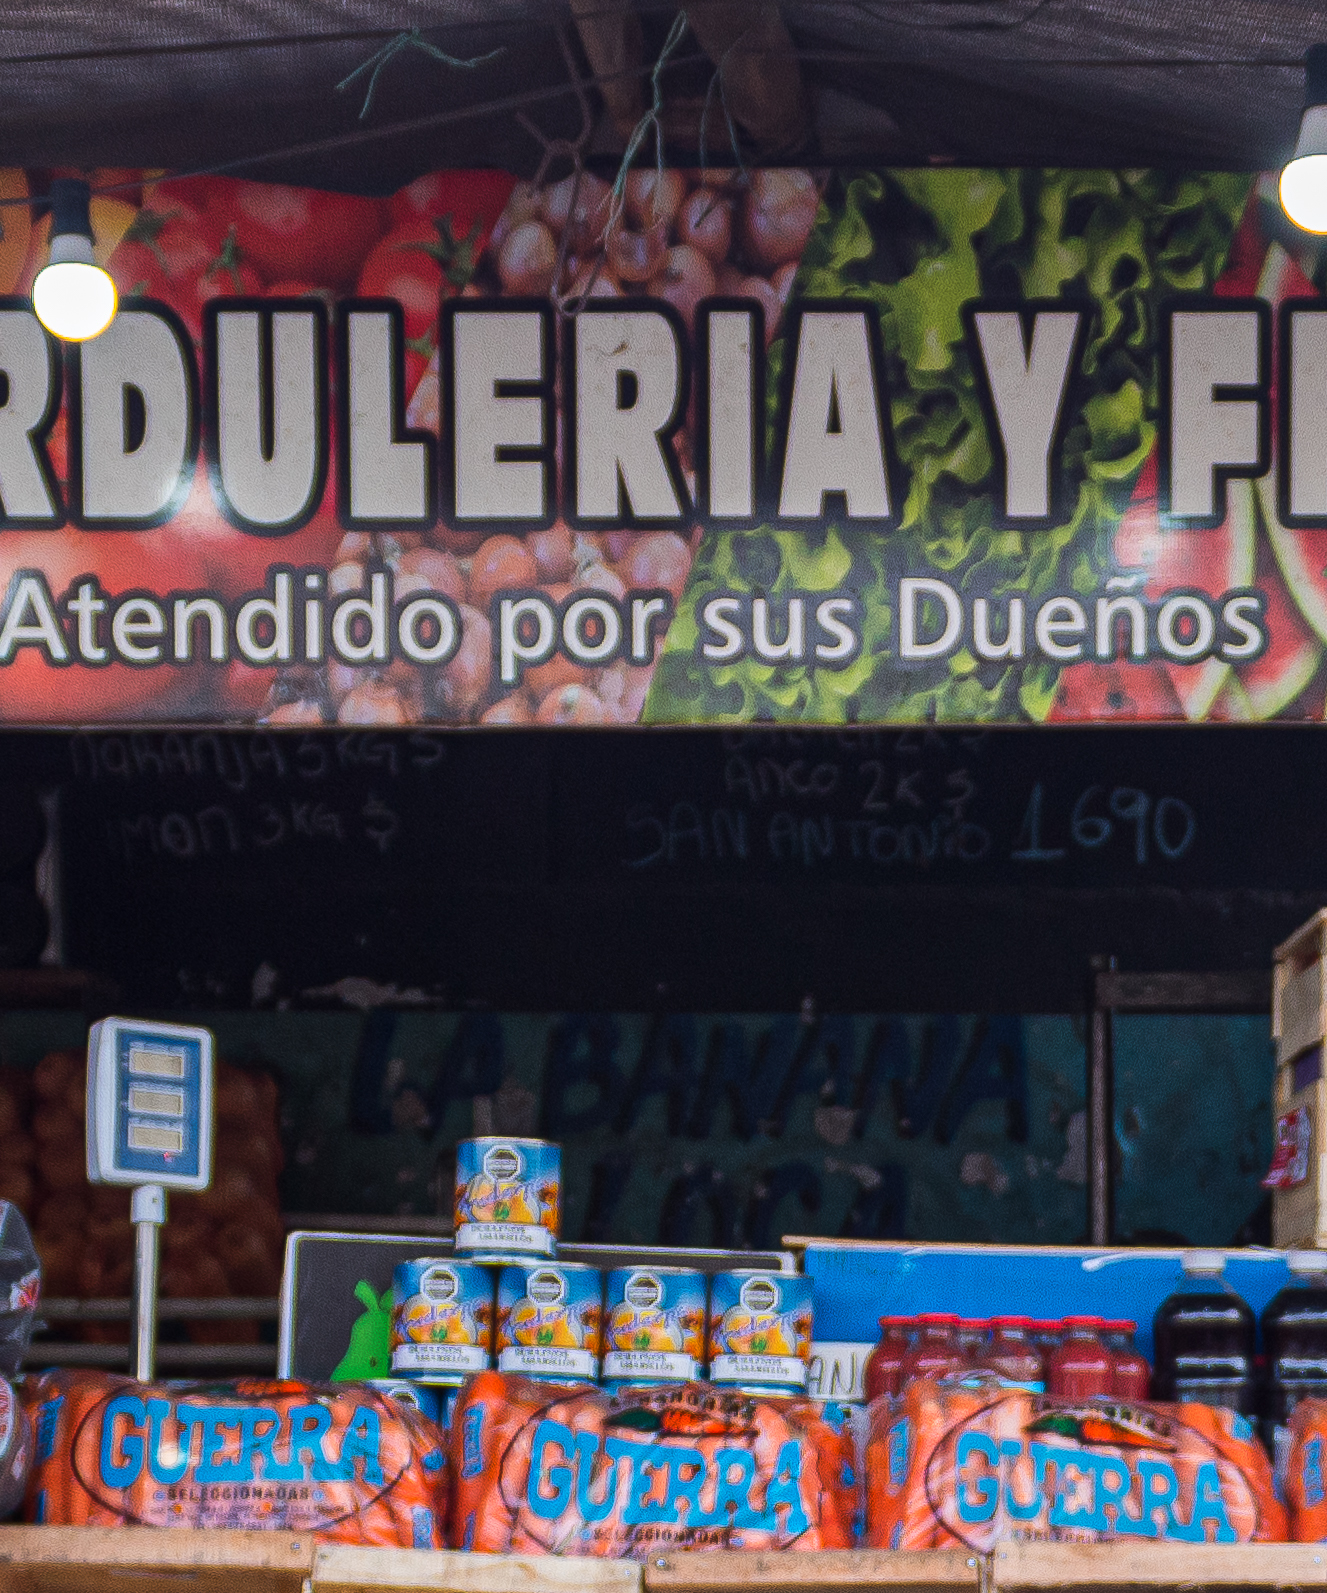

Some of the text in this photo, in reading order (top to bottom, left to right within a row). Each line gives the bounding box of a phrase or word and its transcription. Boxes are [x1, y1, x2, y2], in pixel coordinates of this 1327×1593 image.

[970, 307, 1082, 520] Y
[498, 587, 670, 686] por
[701, 588, 862, 667] sus
[898, 572, 1267, 667] Dueños
[1009, 780, 1197, 866] 1690
[99, 1394, 385, 1489] GUERRA
[525, 1418, 811, 1536] GUERRA
[954, 1430, 1239, 1545] GUERRA
